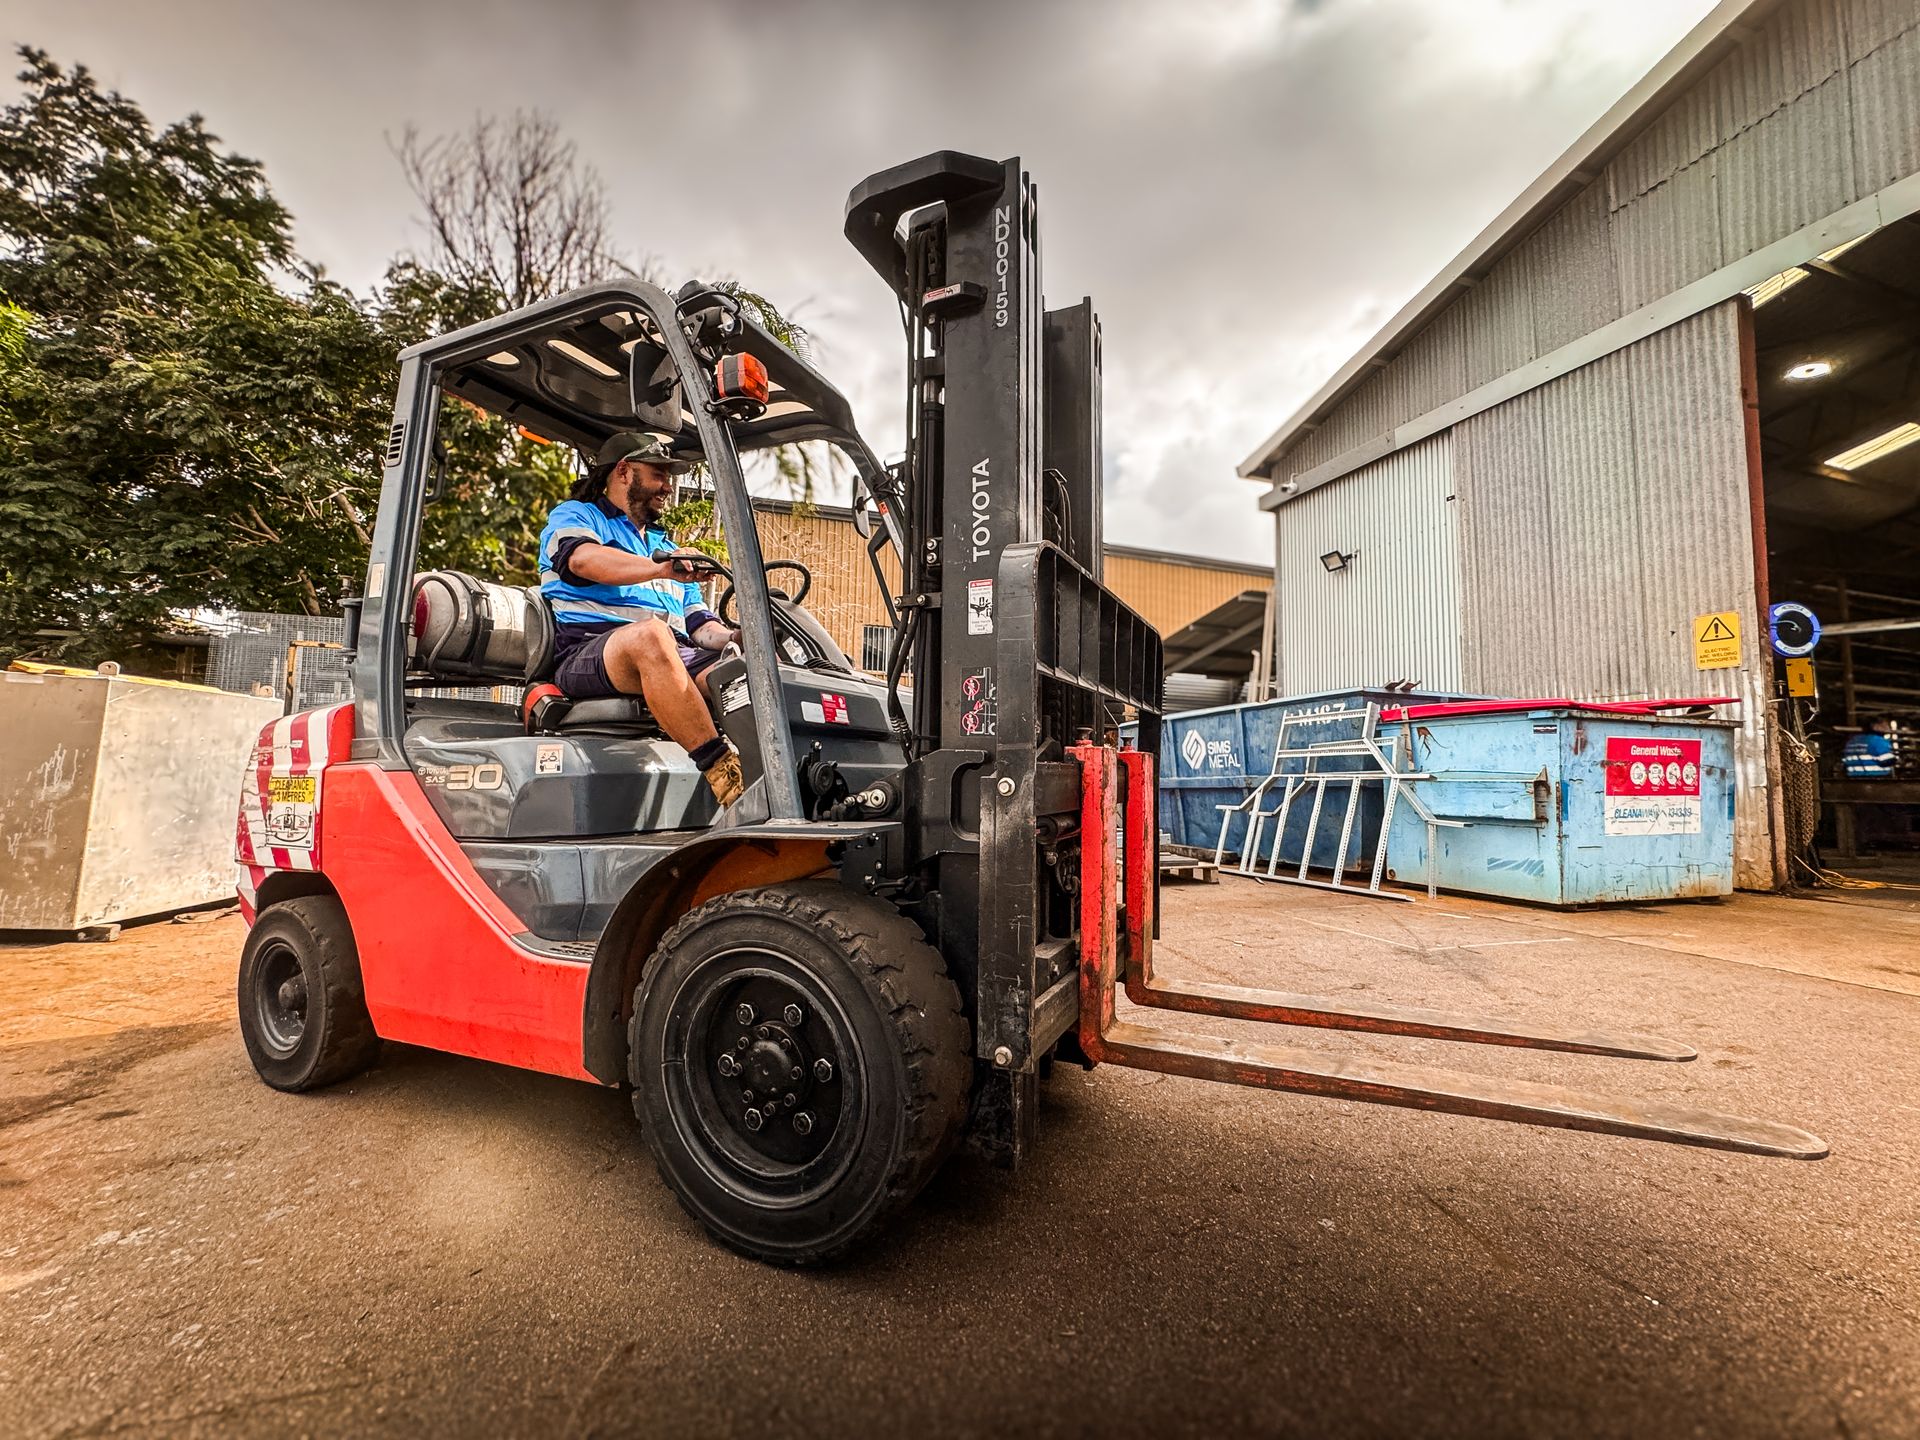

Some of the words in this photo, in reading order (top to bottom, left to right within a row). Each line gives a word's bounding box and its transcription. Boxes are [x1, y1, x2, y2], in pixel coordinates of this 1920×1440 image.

[994, 205, 1010, 328] ND00159
[972, 457, 991, 563] TOYOTA
[1712, 650, 1738, 658] WELDING
[1207, 740, 1231, 755] SIMS
[1630, 744, 1659, 757] General
[1208, 752, 1242, 769] METAL
[425, 776, 446, 784] SAS
[446, 763, 504, 790] 30
[276, 791, 281, 802] 3
[282, 791, 306, 803] METRES
